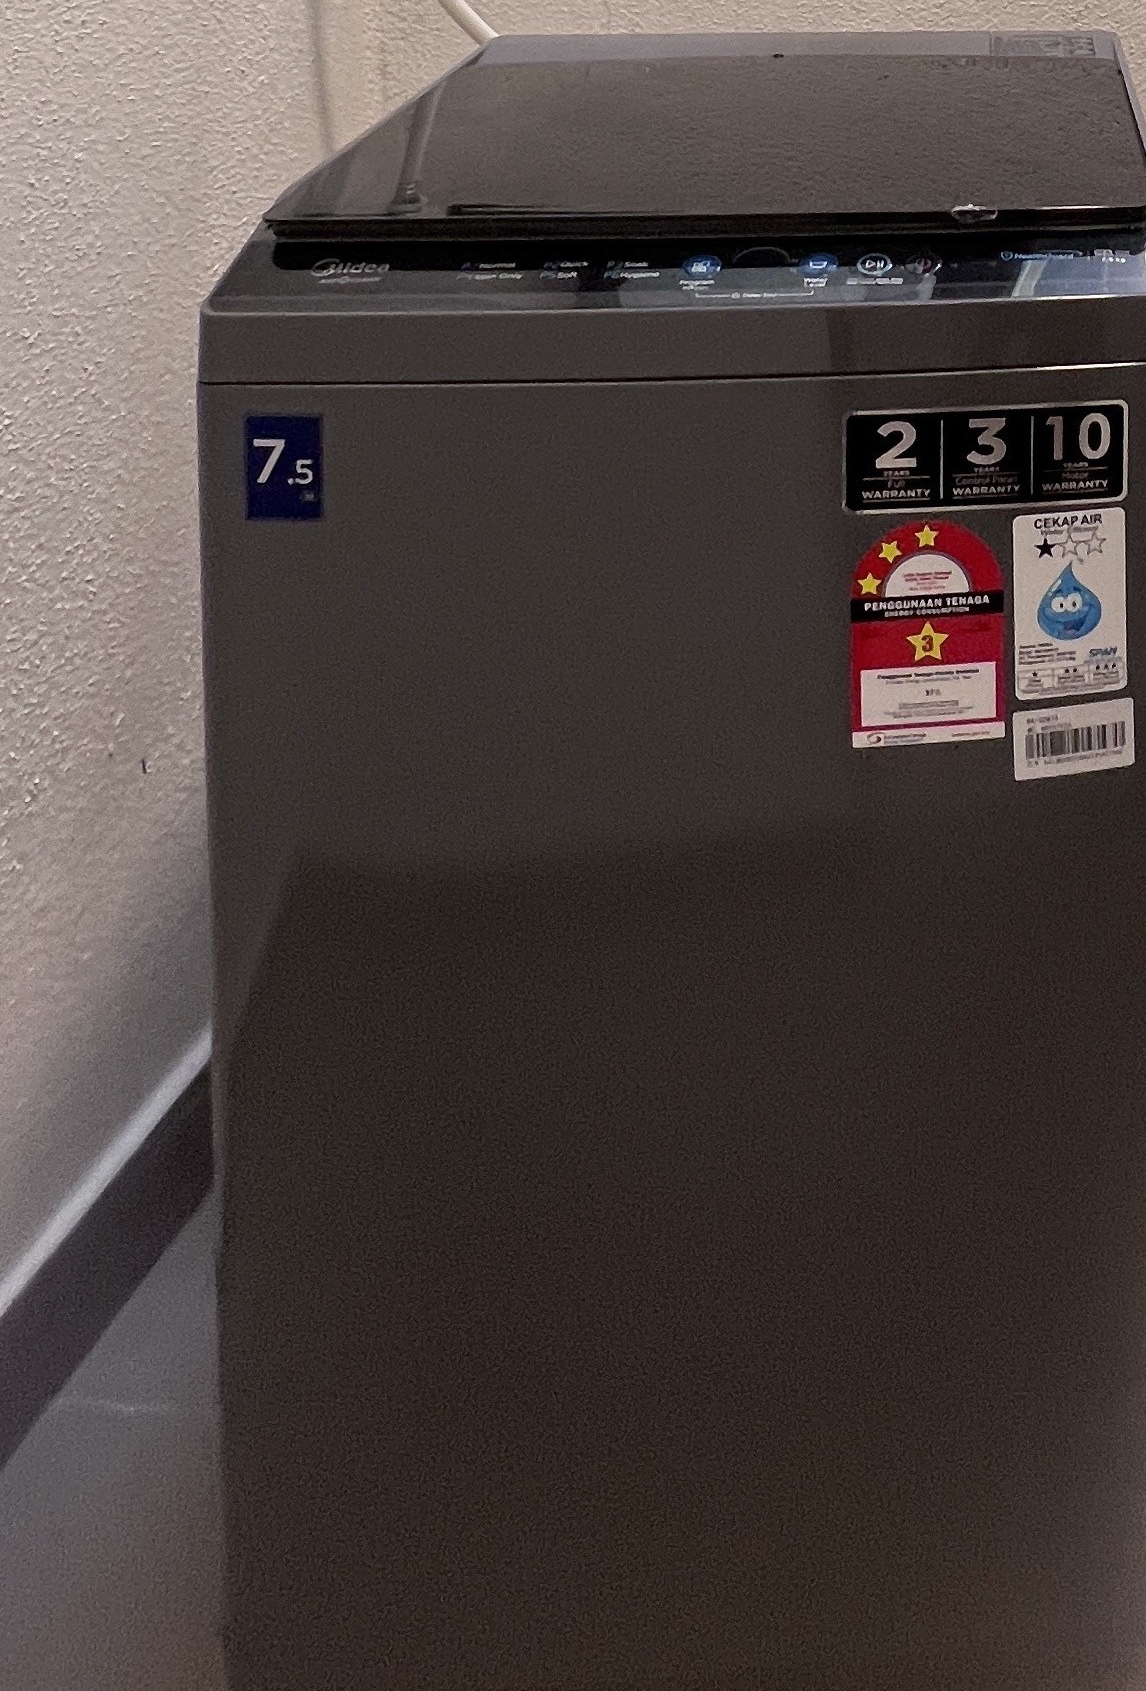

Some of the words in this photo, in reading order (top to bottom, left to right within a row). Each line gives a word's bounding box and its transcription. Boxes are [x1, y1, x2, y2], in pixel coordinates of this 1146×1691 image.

[875, 420, 917, 469] 2
[966, 417, 1007, 465] 3
[1045, 412, 1111, 460] 10
[861, 488, 931, 500] WARRANTY
[952, 484, 1021, 496] WARRANTY
[1041, 479, 1109, 492] WARRANTY
[1034, 515, 1079, 529] CEKAP
[1080, 513, 1103, 526] AIR
[864, 598, 943, 612] PENGGUNAAN
[945, 594, 990, 607] TENAGA
[920, 634, 934, 653] 3
